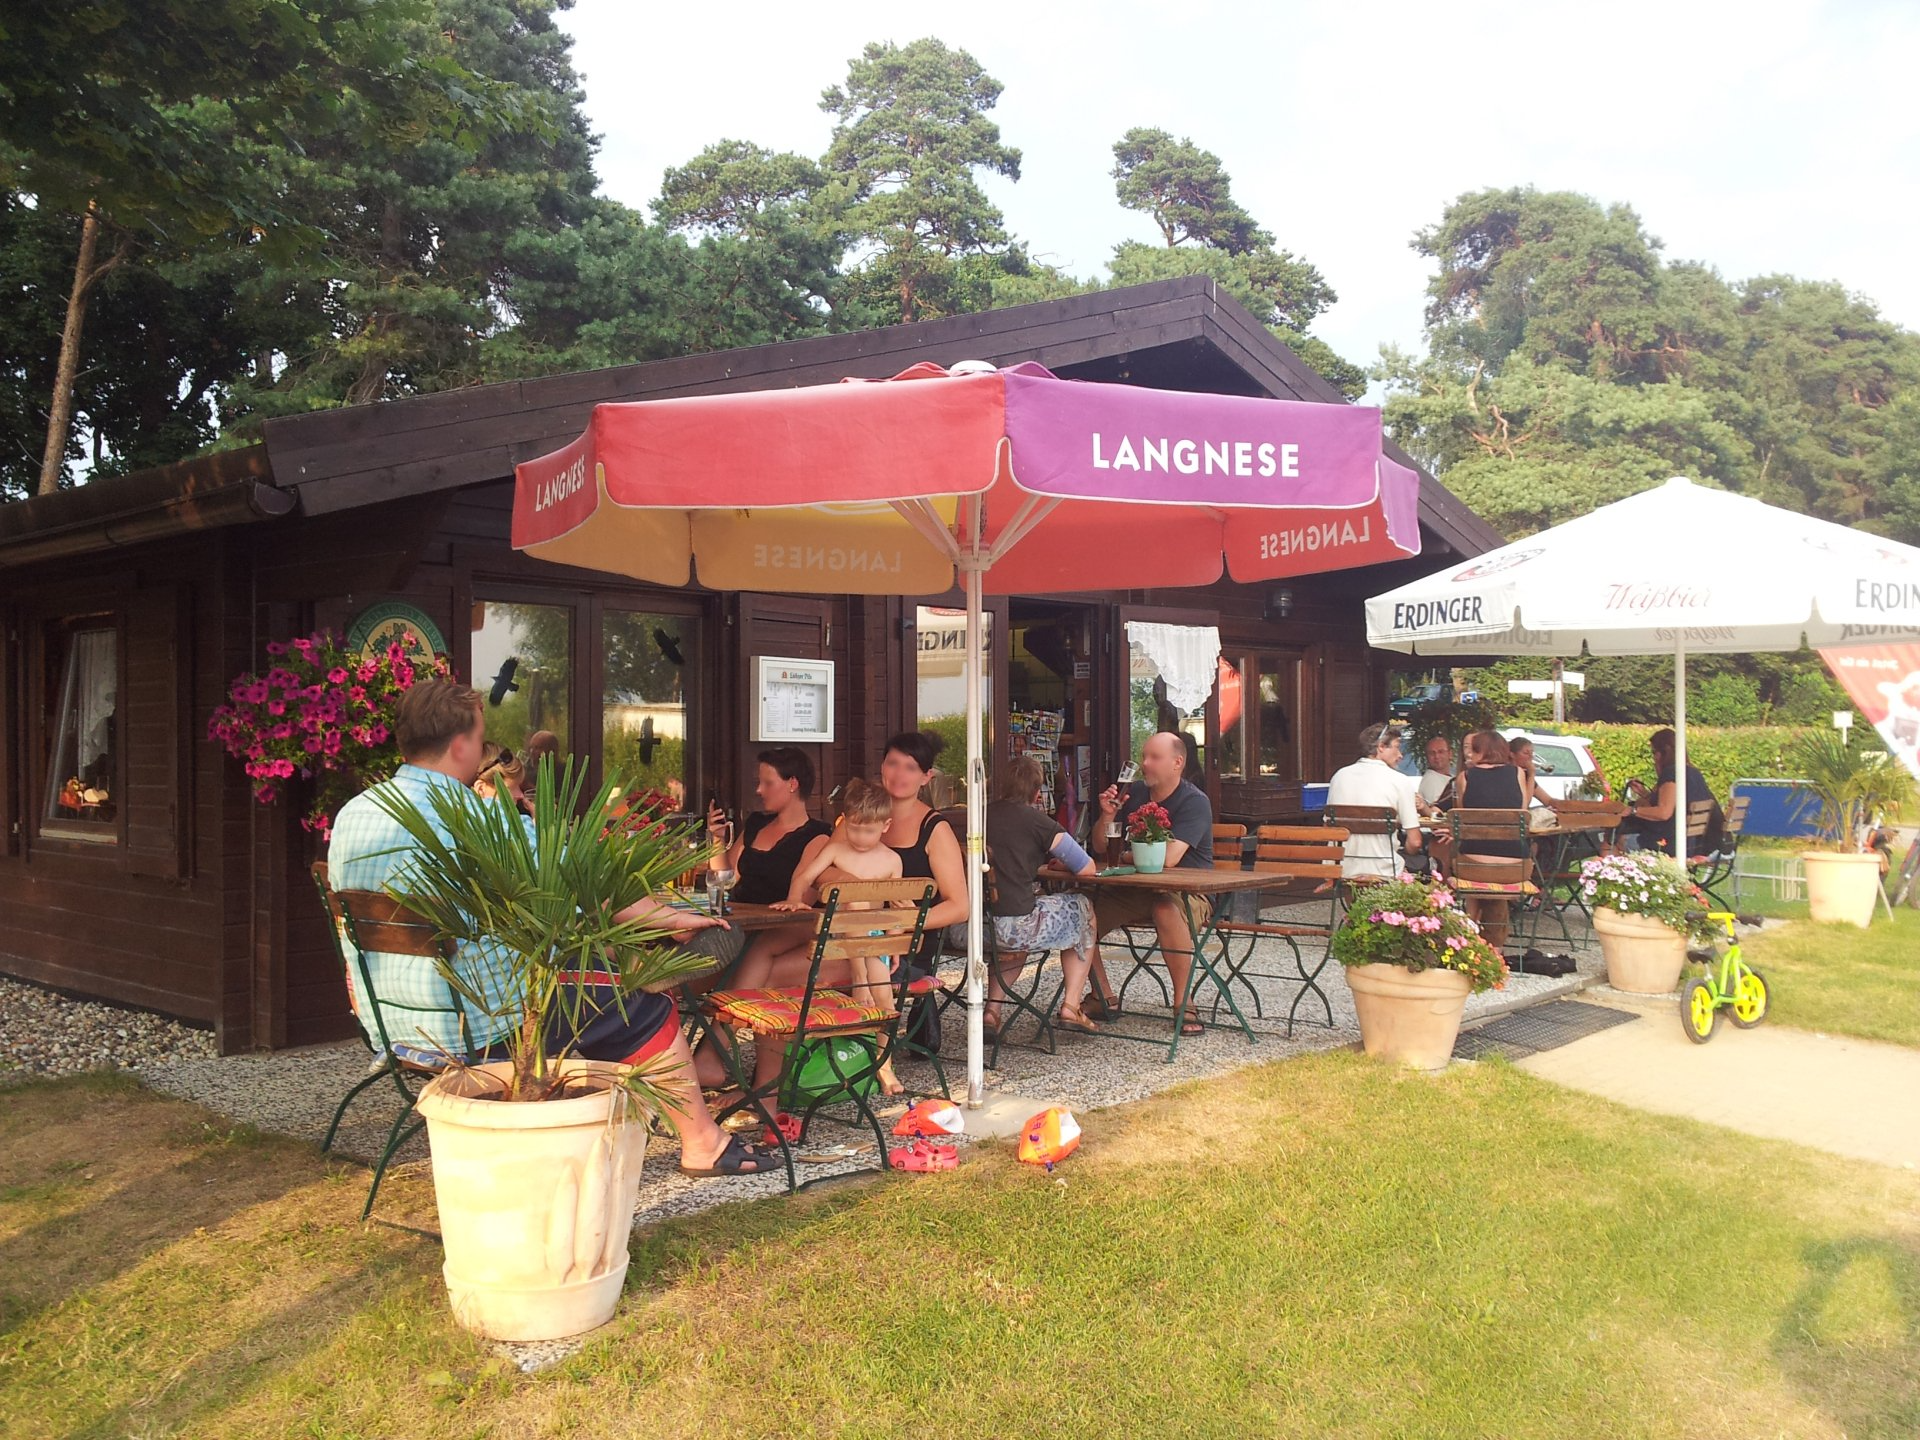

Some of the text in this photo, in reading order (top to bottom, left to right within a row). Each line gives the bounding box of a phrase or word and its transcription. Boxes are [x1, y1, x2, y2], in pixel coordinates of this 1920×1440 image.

[1092, 431, 1300, 478] LANGNESE
[535, 455, 585, 512] LANGNESE
[1393, 596, 1484, 631] ERDINGER
